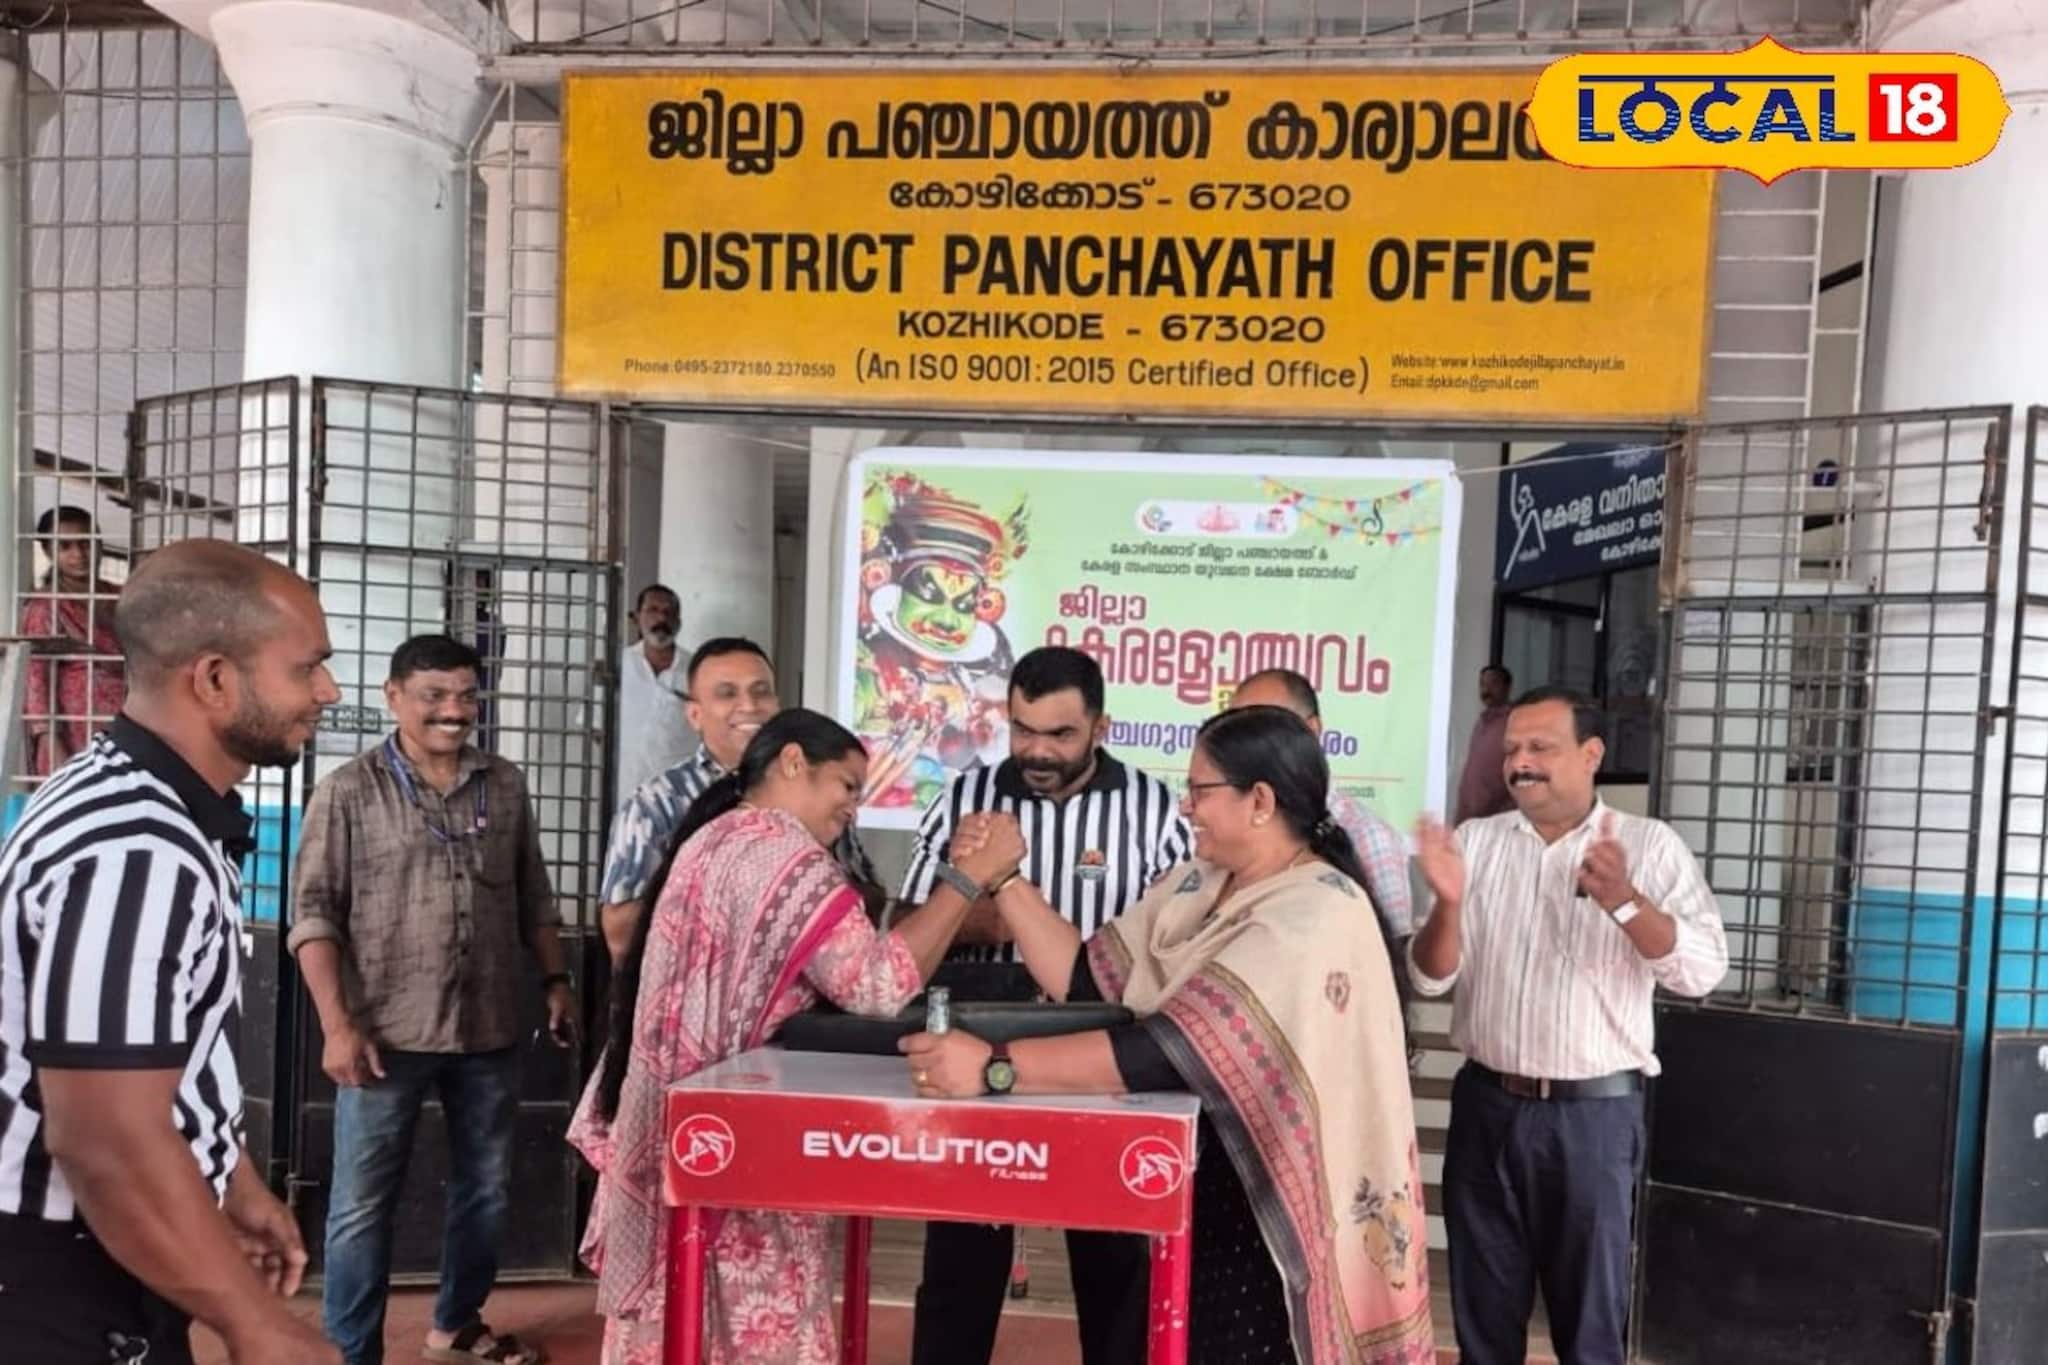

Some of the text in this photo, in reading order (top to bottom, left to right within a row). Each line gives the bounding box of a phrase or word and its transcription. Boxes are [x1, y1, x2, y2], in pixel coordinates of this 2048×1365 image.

[648, 88, 804, 176] ജില്ലാ
[827, 90, 1230, 161] പഞ്ചായത്ത്
[889, 173, 1157, 211] കോഴിക്കോട്
[1188, 181, 1350, 212] 673020
[662, 232, 1596, 304] DISTRICT PANCHAYATH OFFICE
[899, 311, 1104, 341] KOZHIKODE
[1160, 314, 1326, 344] 673020
[856, 347, 899, 383] (An
[909, 354, 958, 381] ISO
[1129, 356, 1254, 387] Certified
[1266, 357, 1369, 394] Office)
[1059, 585, 1148, 625] ജില്ലാ
[803, 1130, 1049, 1169] EVOLUTION
